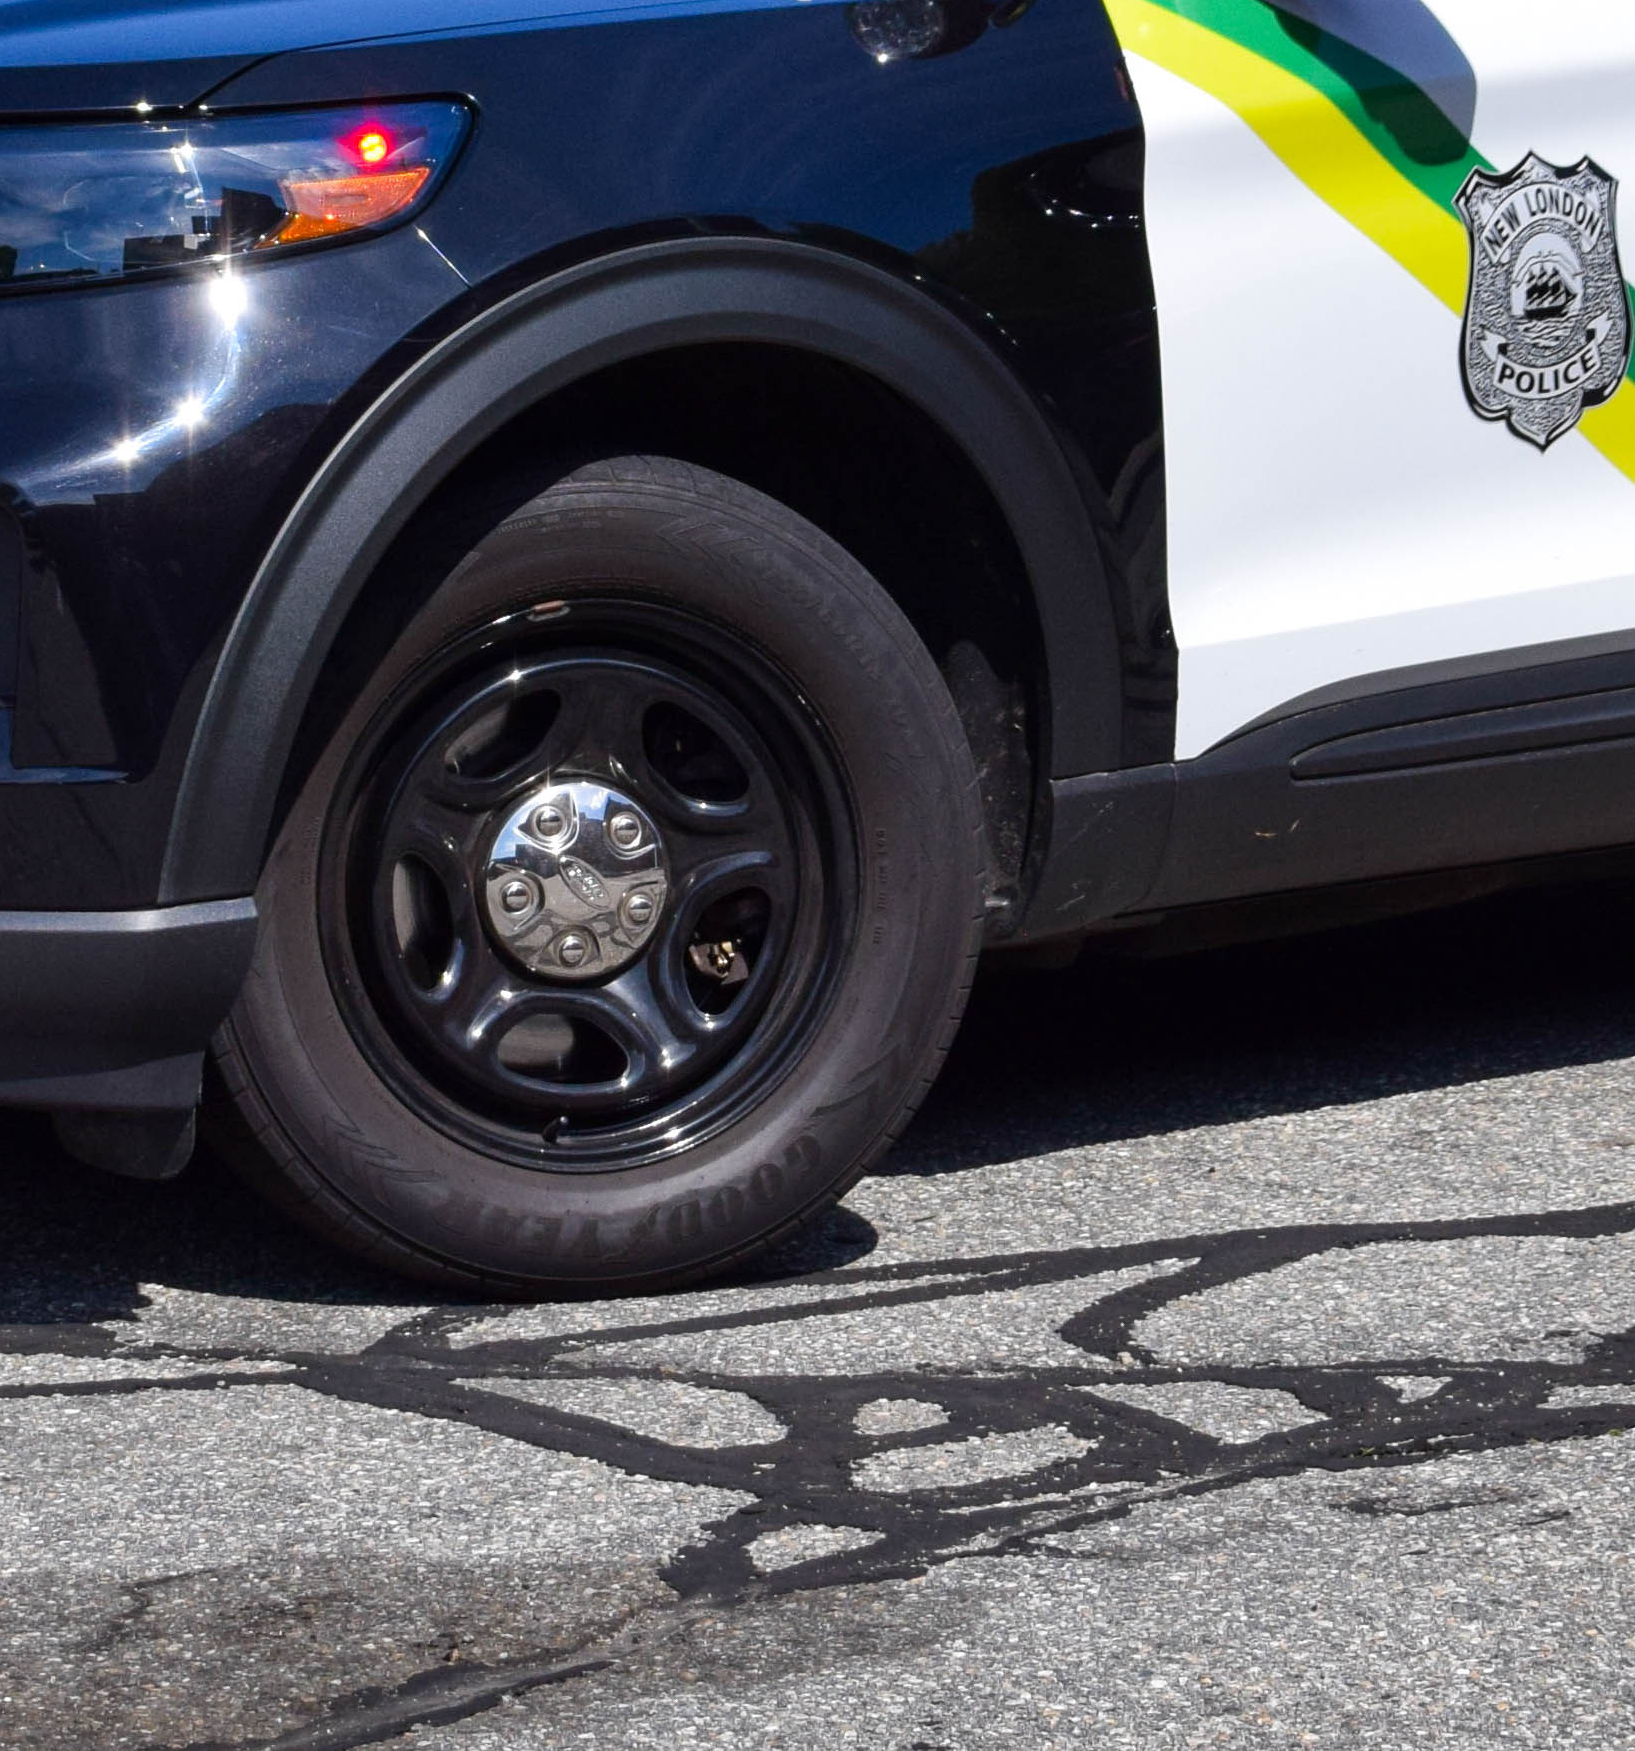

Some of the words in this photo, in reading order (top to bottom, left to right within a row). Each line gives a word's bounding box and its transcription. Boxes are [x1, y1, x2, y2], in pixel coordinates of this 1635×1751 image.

[1484, 209, 1523, 251] NEW
[1524, 186, 1603, 238] LONDON
[1497, 348, 1597, 394] POLICE
